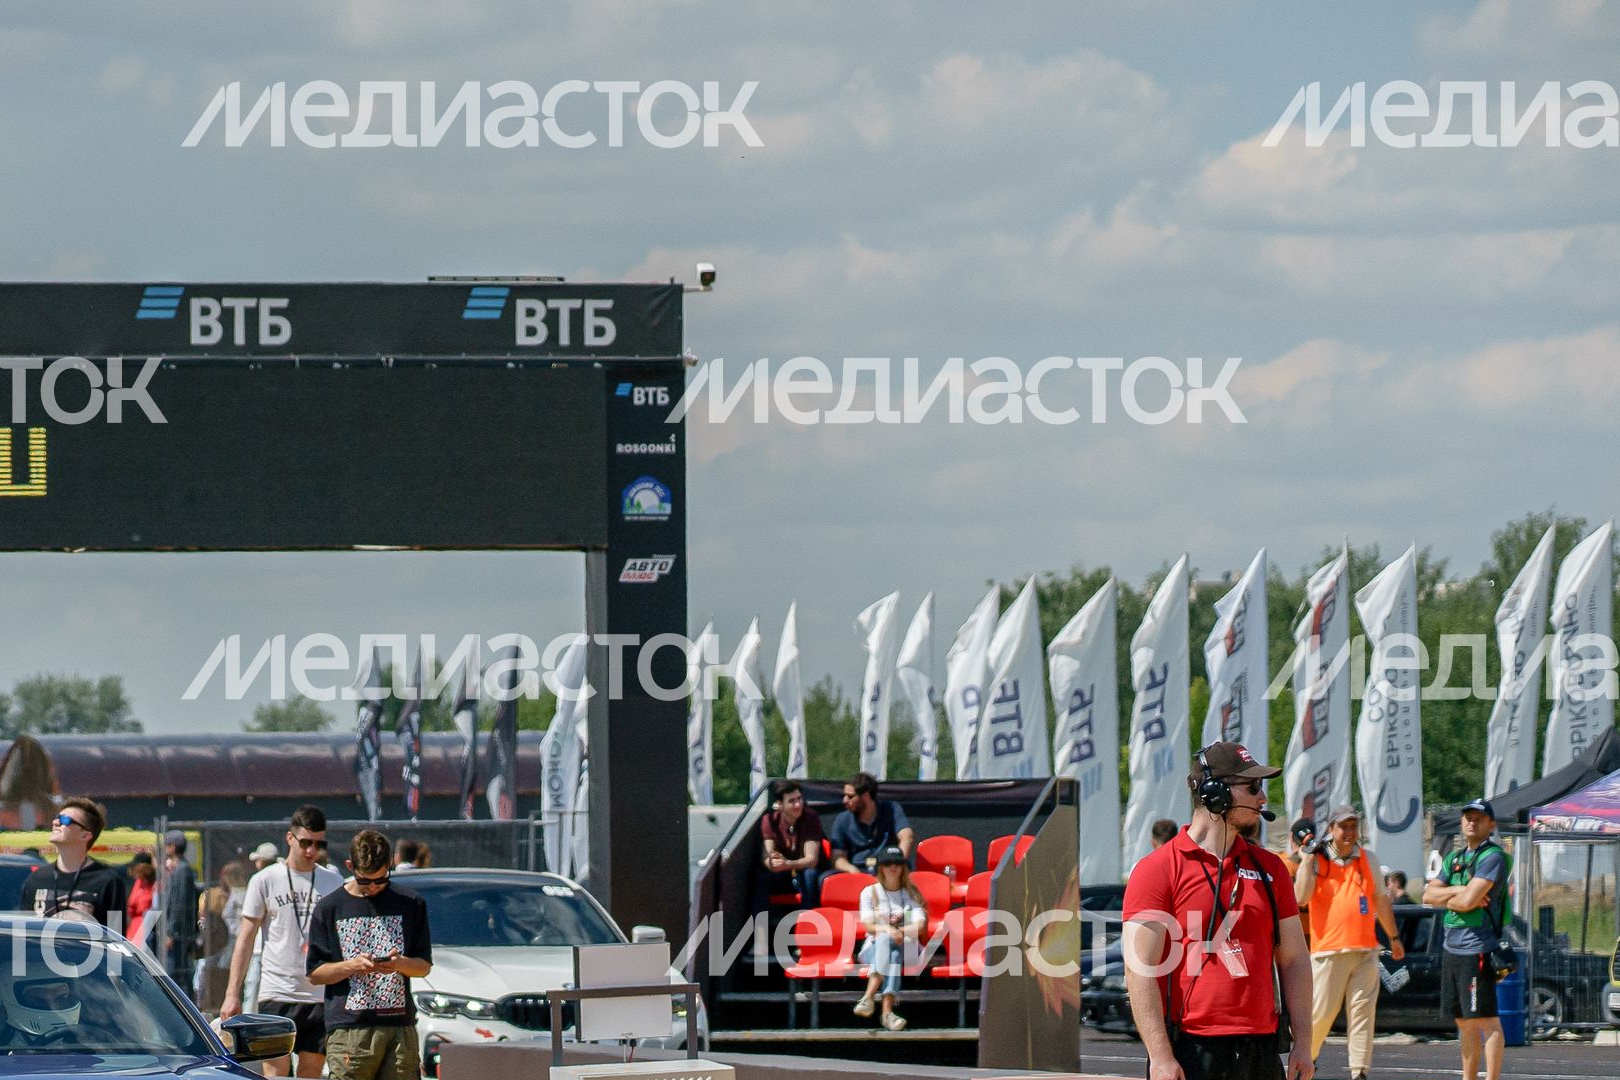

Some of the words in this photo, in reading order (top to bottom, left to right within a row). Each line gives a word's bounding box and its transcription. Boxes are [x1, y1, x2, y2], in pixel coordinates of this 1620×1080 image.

[190, 297, 292, 346] ВТБ
[516, 298, 617, 347] ВТБ
[633, 386, 670, 406] ВТБ
